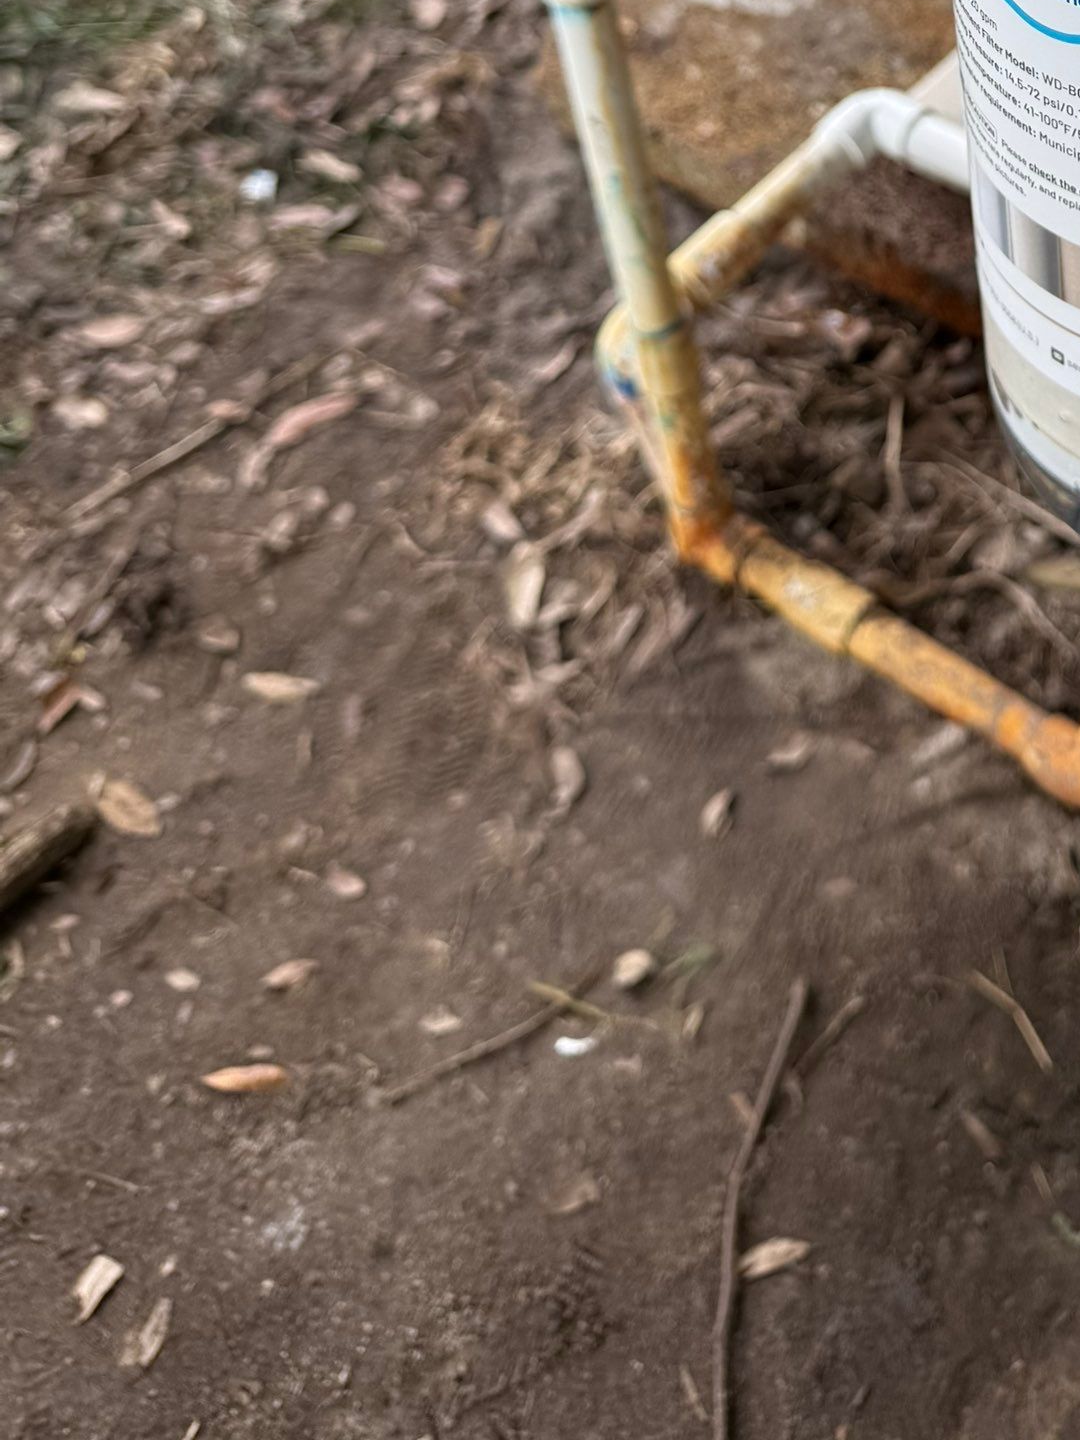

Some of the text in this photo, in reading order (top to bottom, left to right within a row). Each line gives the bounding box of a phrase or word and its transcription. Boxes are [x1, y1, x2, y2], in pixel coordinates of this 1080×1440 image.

[981, 28, 1005, 55] Filter
[1005, 51, 1040, 80] Model:
[1004, 69, 1041, 101] 14.5-72
[1028, 162, 1058, 185] check
[1058, 178, 1077, 194] the
[1039, 184, 1057, 200] and
